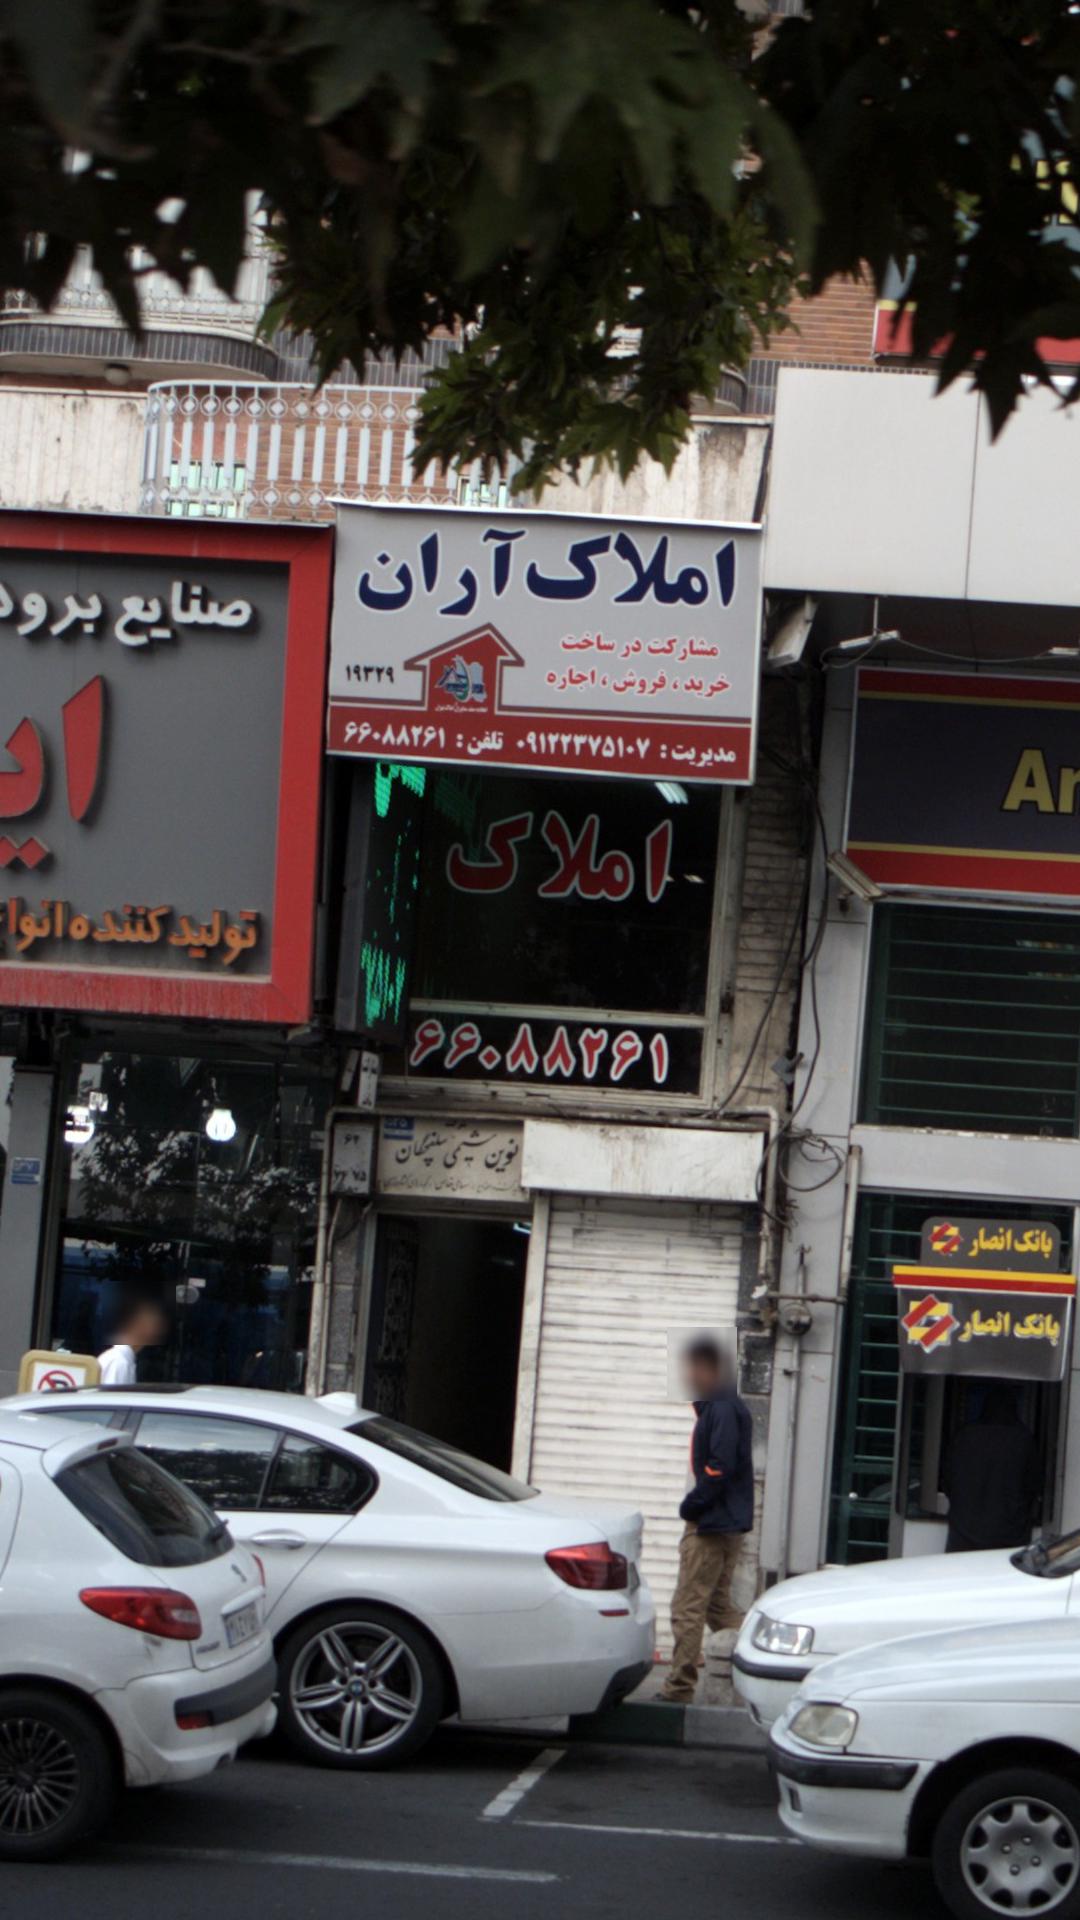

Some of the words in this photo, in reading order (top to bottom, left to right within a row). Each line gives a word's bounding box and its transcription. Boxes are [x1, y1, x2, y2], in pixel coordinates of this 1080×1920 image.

[357, 528, 527, 616] آران
[526, 531, 737, 608] املاک
[114, 581, 253, 646] صنایع
[561, 633, 616, 652] ساخت
[620, 638, 643, 659] در
[648, 637, 720, 661] مشارکت
[546, 667, 597, 690] اجاره
[344, 721, 446, 749] ۶۶۰۸۸۲۶۱
[446, 810, 673, 903] املاک
[0, 896, 65, 952] انوا
[69, 904, 171, 943] کننده
[168, 908, 257, 966] تولید
[409, 1018, 669, 1084] ۶۶۰۸۸۲۶۱
[968, 1226, 1013, 1257] انصار
[1013, 1228, 1053, 1258] بانک
[957, 1309, 1011, 1343] انصار
[1013, 1313, 1060, 1347] بانک
